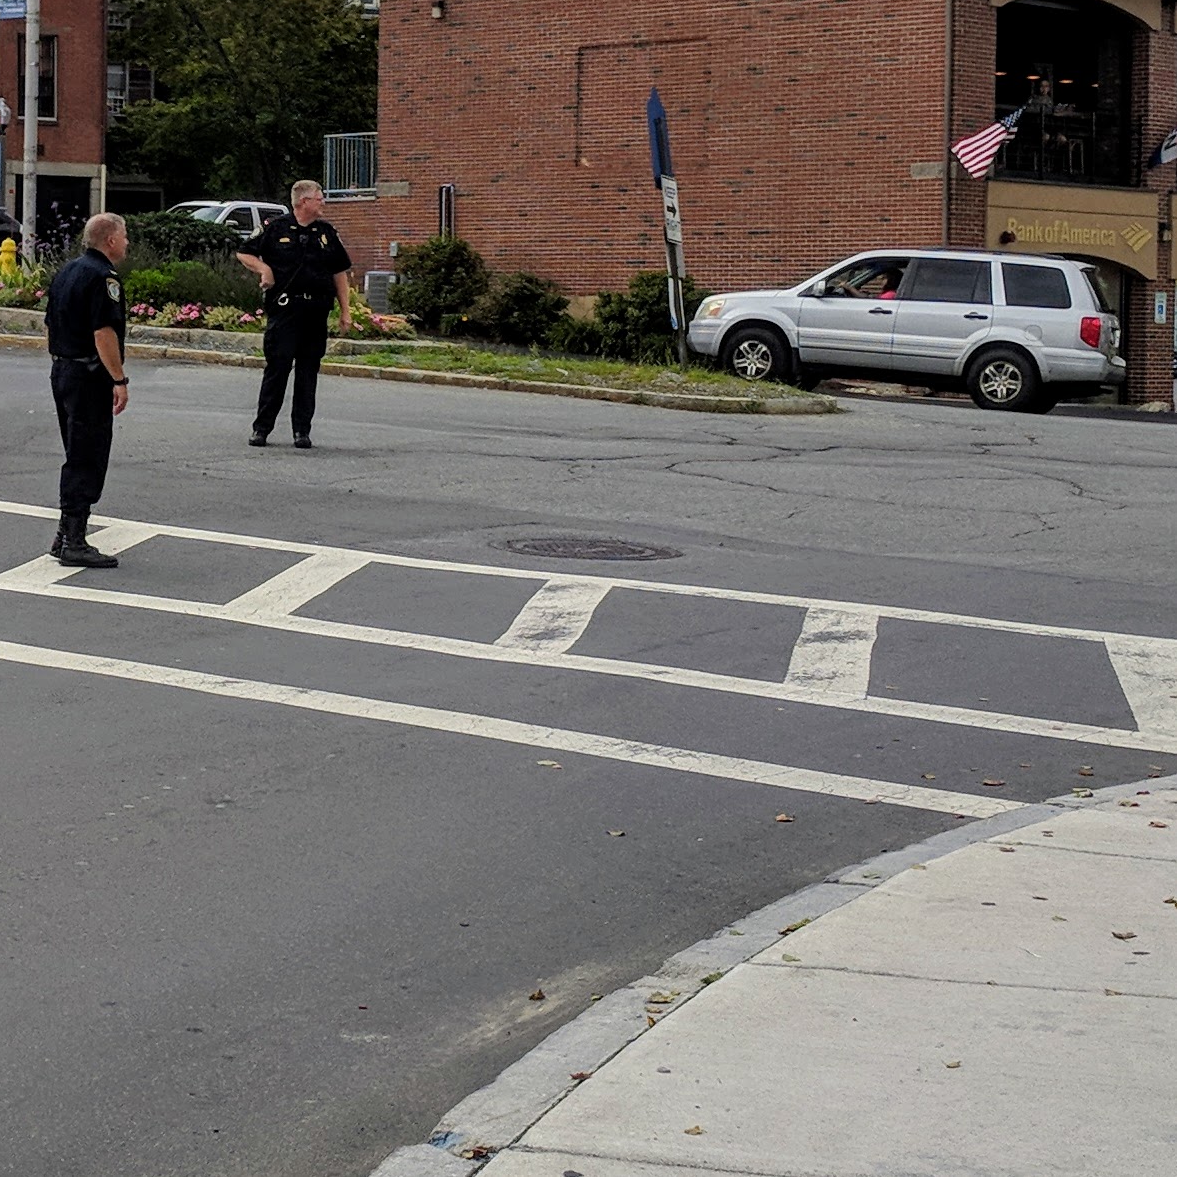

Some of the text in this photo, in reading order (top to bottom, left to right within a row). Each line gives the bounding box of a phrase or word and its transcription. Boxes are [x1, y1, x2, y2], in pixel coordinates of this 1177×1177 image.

[1007, 218, 1117, 247] Bank of America
